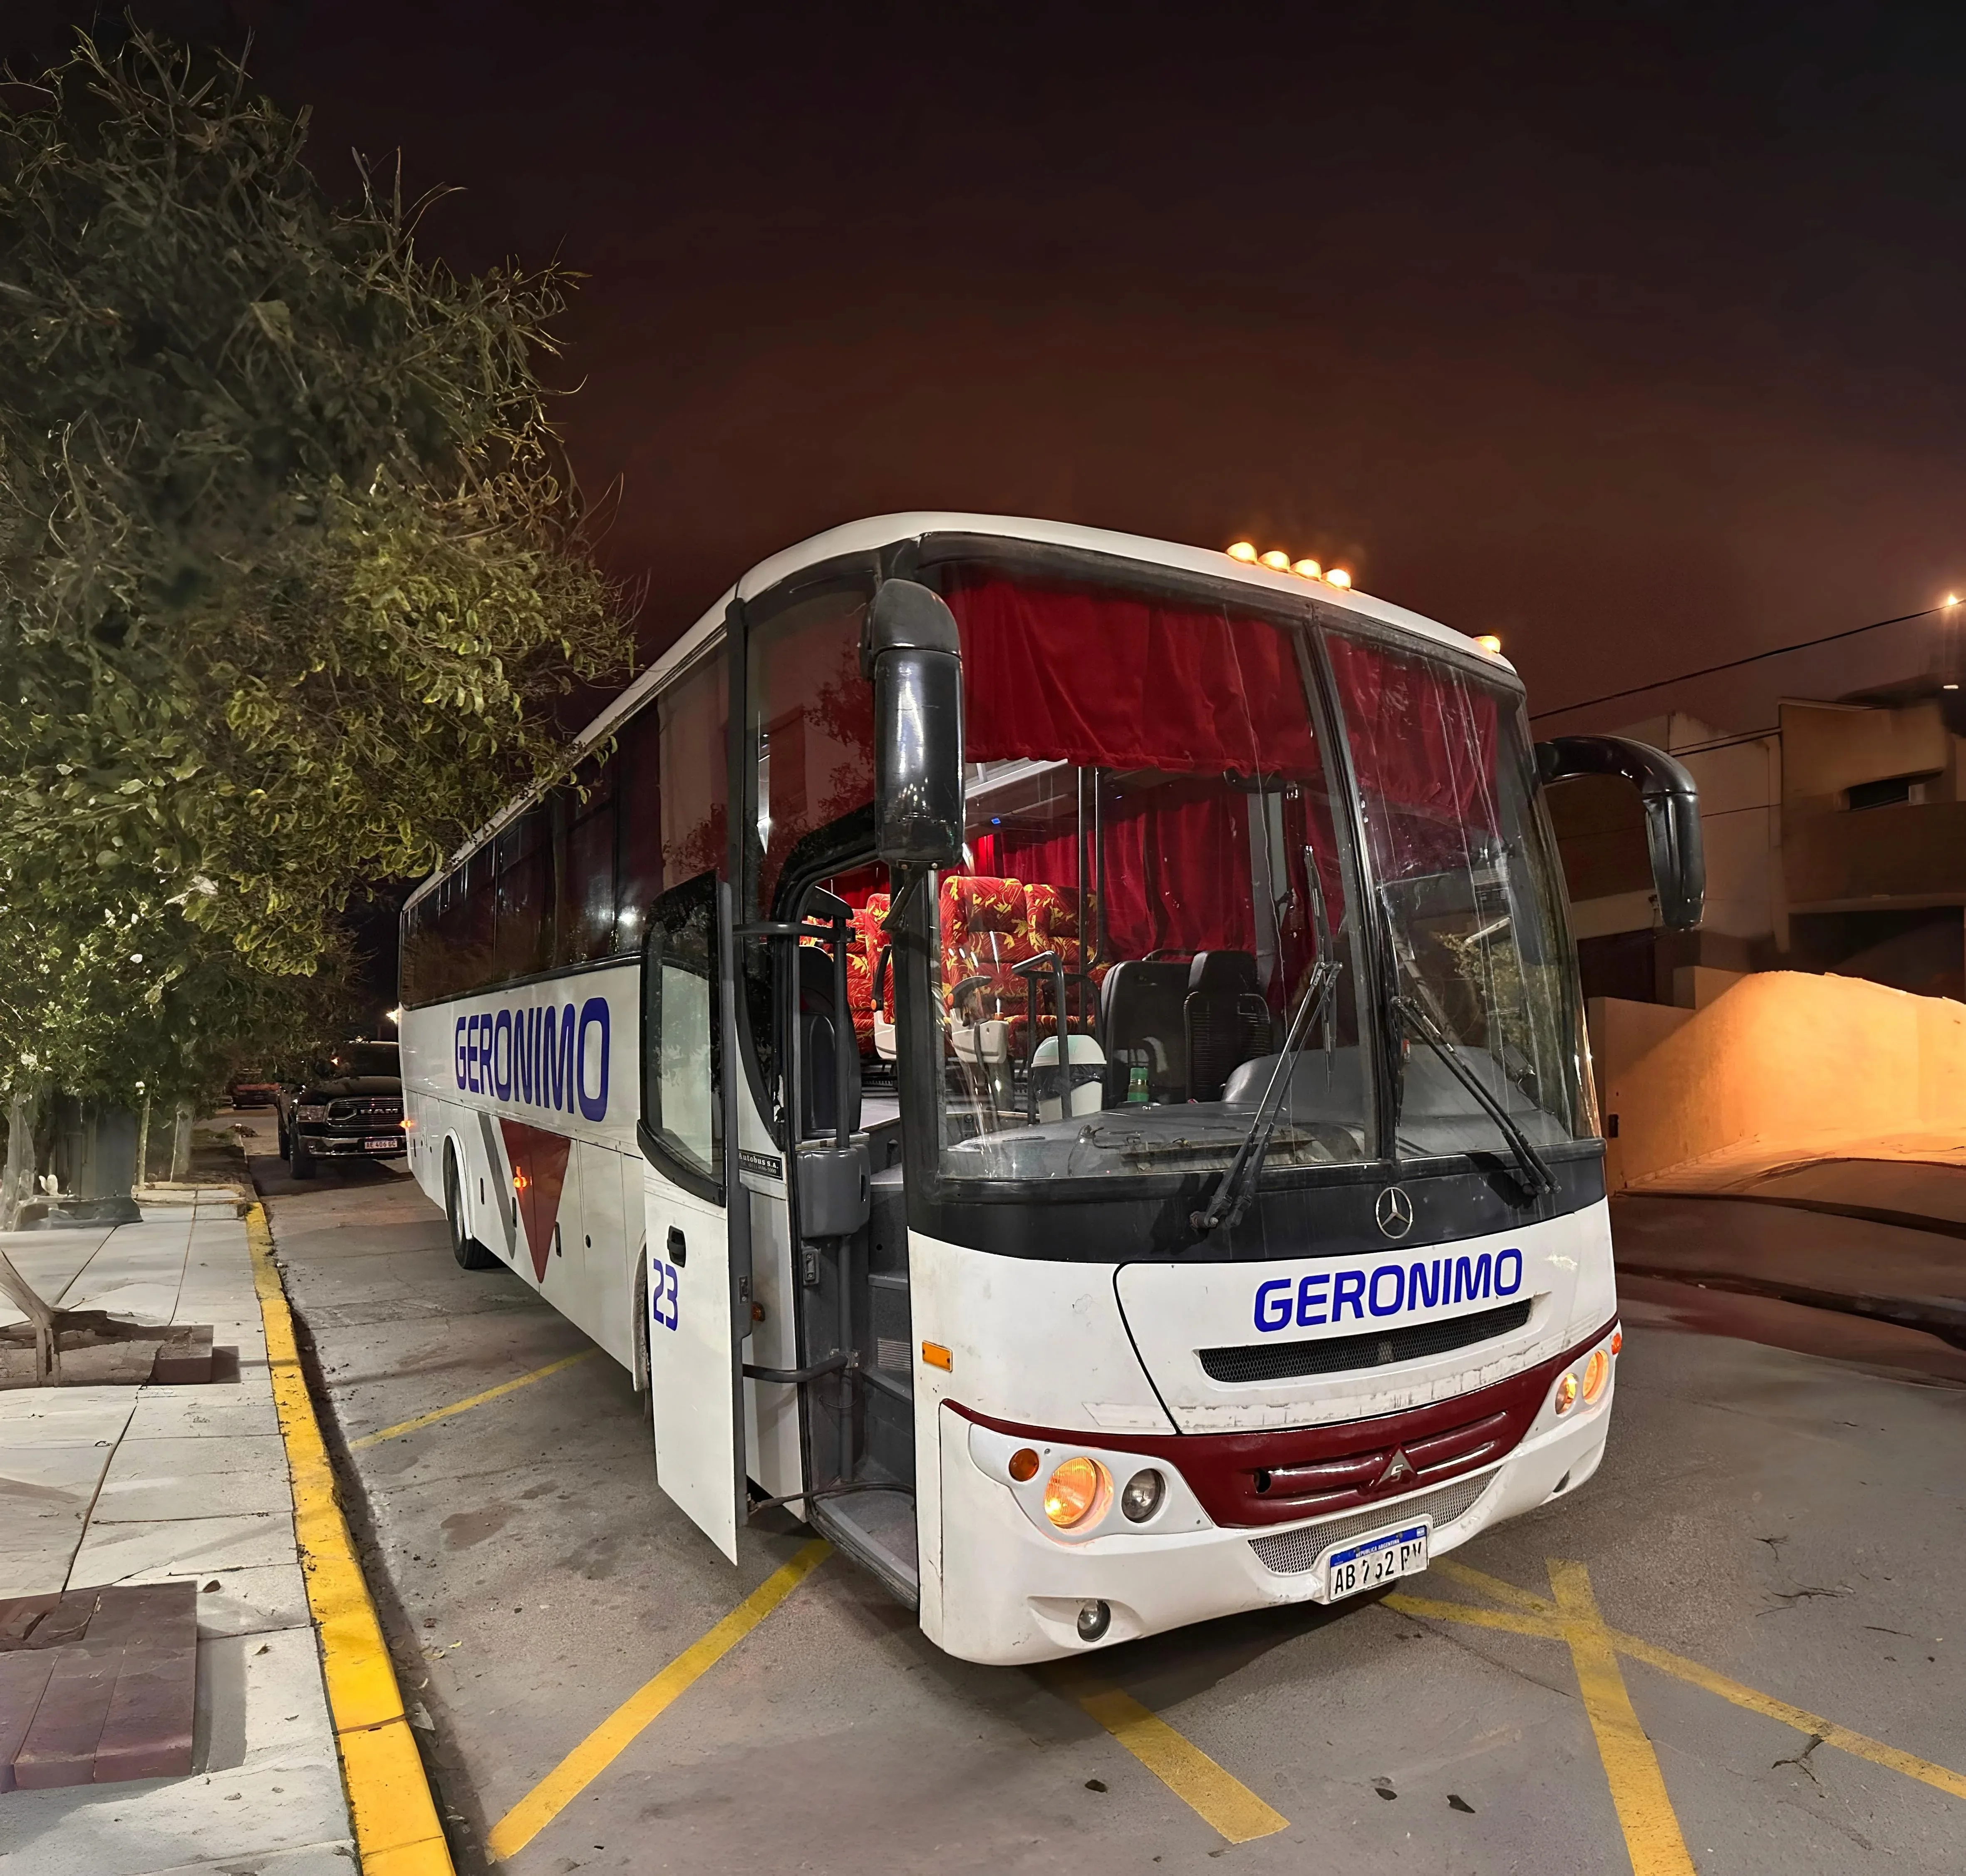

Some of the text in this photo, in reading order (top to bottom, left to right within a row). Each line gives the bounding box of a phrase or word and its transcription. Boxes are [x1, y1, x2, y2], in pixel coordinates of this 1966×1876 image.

[455, 997, 610, 1122] GERONIMO
[739, 1152, 766, 1165] Autobus
[654, 1258, 678, 1331] 23
[1254, 1249, 1522, 1332] GERONIMO
[1378, 1539, 1400, 1550] ARGENTINA
[1335, 1564, 1355, 1594] AB
